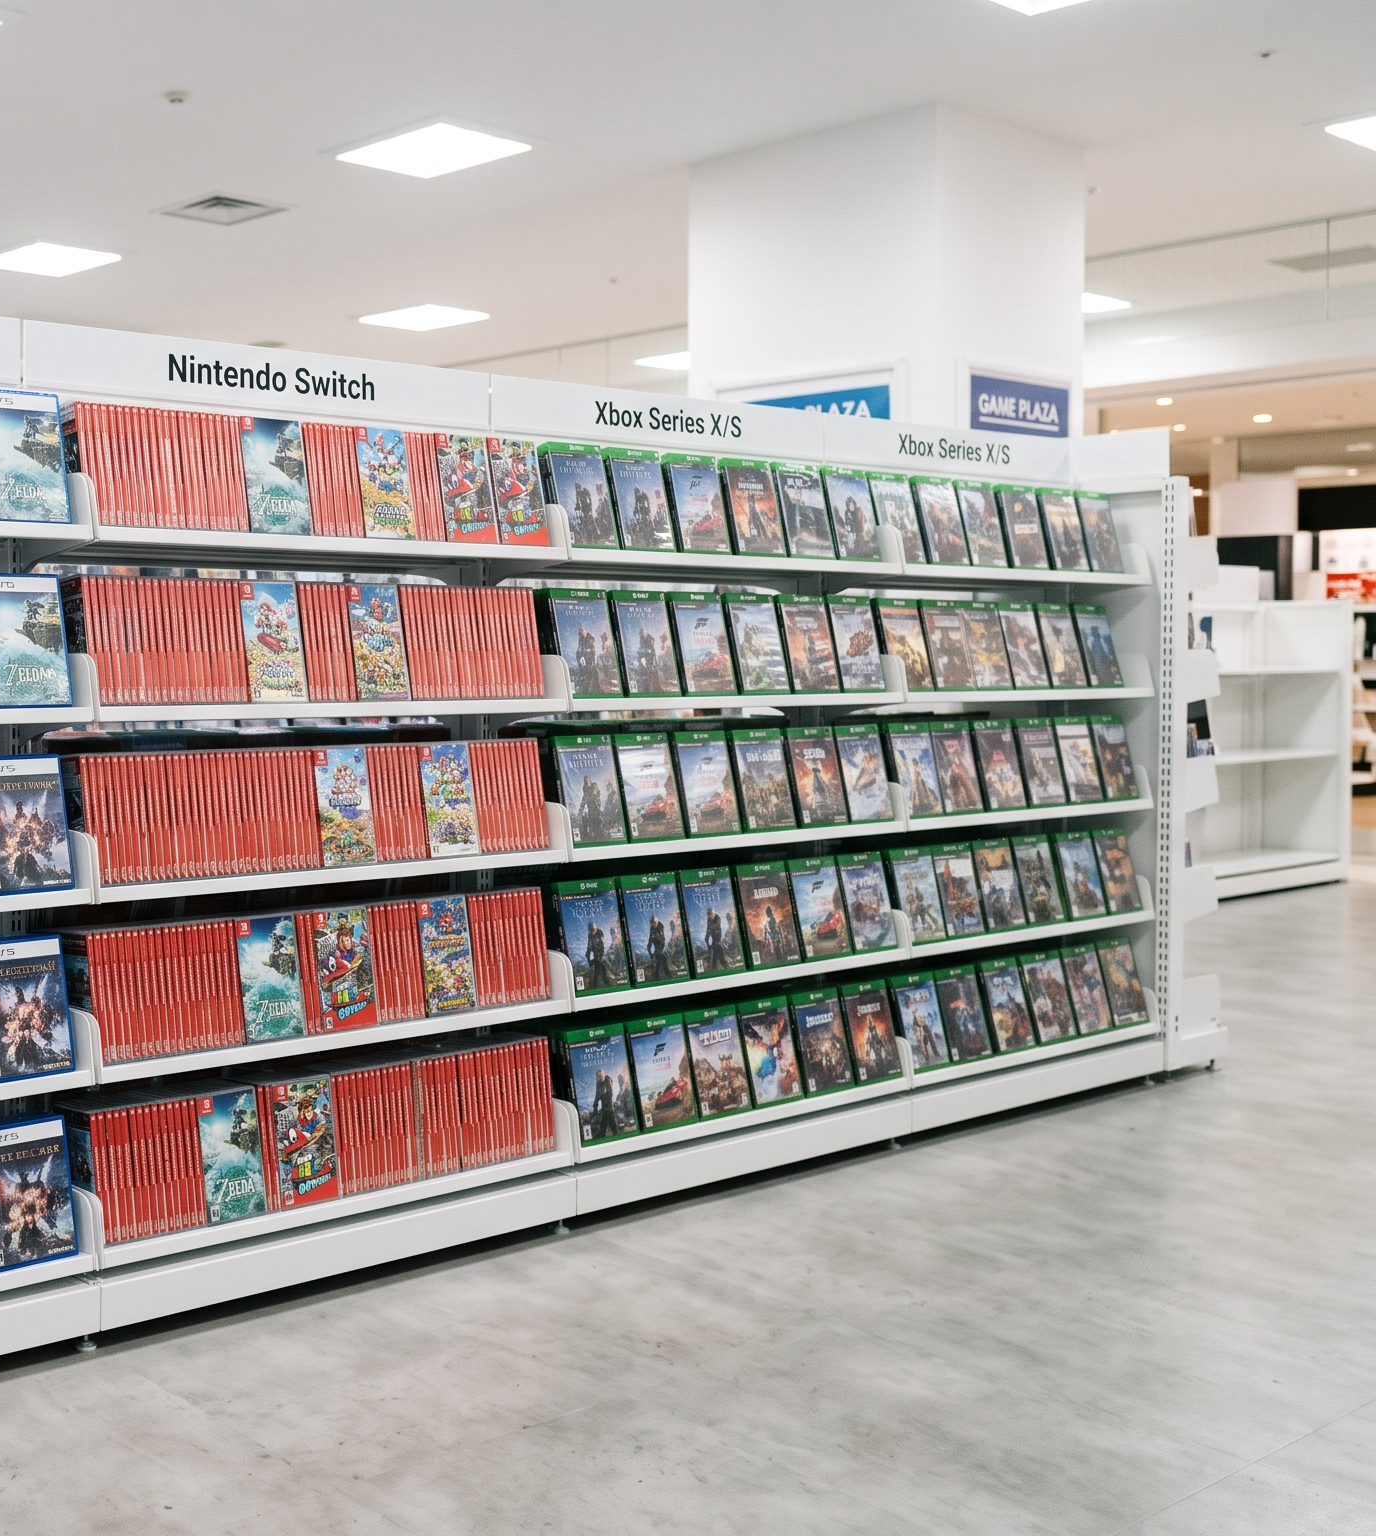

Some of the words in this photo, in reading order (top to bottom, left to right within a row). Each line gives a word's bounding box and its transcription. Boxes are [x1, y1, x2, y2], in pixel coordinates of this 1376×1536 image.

[168, 354, 287, 392] Nintendo
[295, 367, 376, 401] Switch
[595, 400, 643, 429] Xbox
[649, 406, 705, 435] Series
[710, 413, 742, 438] X/S
[978, 393, 1017, 418] GAME
[1018, 398, 1059, 424] PLAZA
[898, 433, 934, 458] Xbox
[938, 438, 982, 462] Series
[986, 443, 1010, 465] X/S
